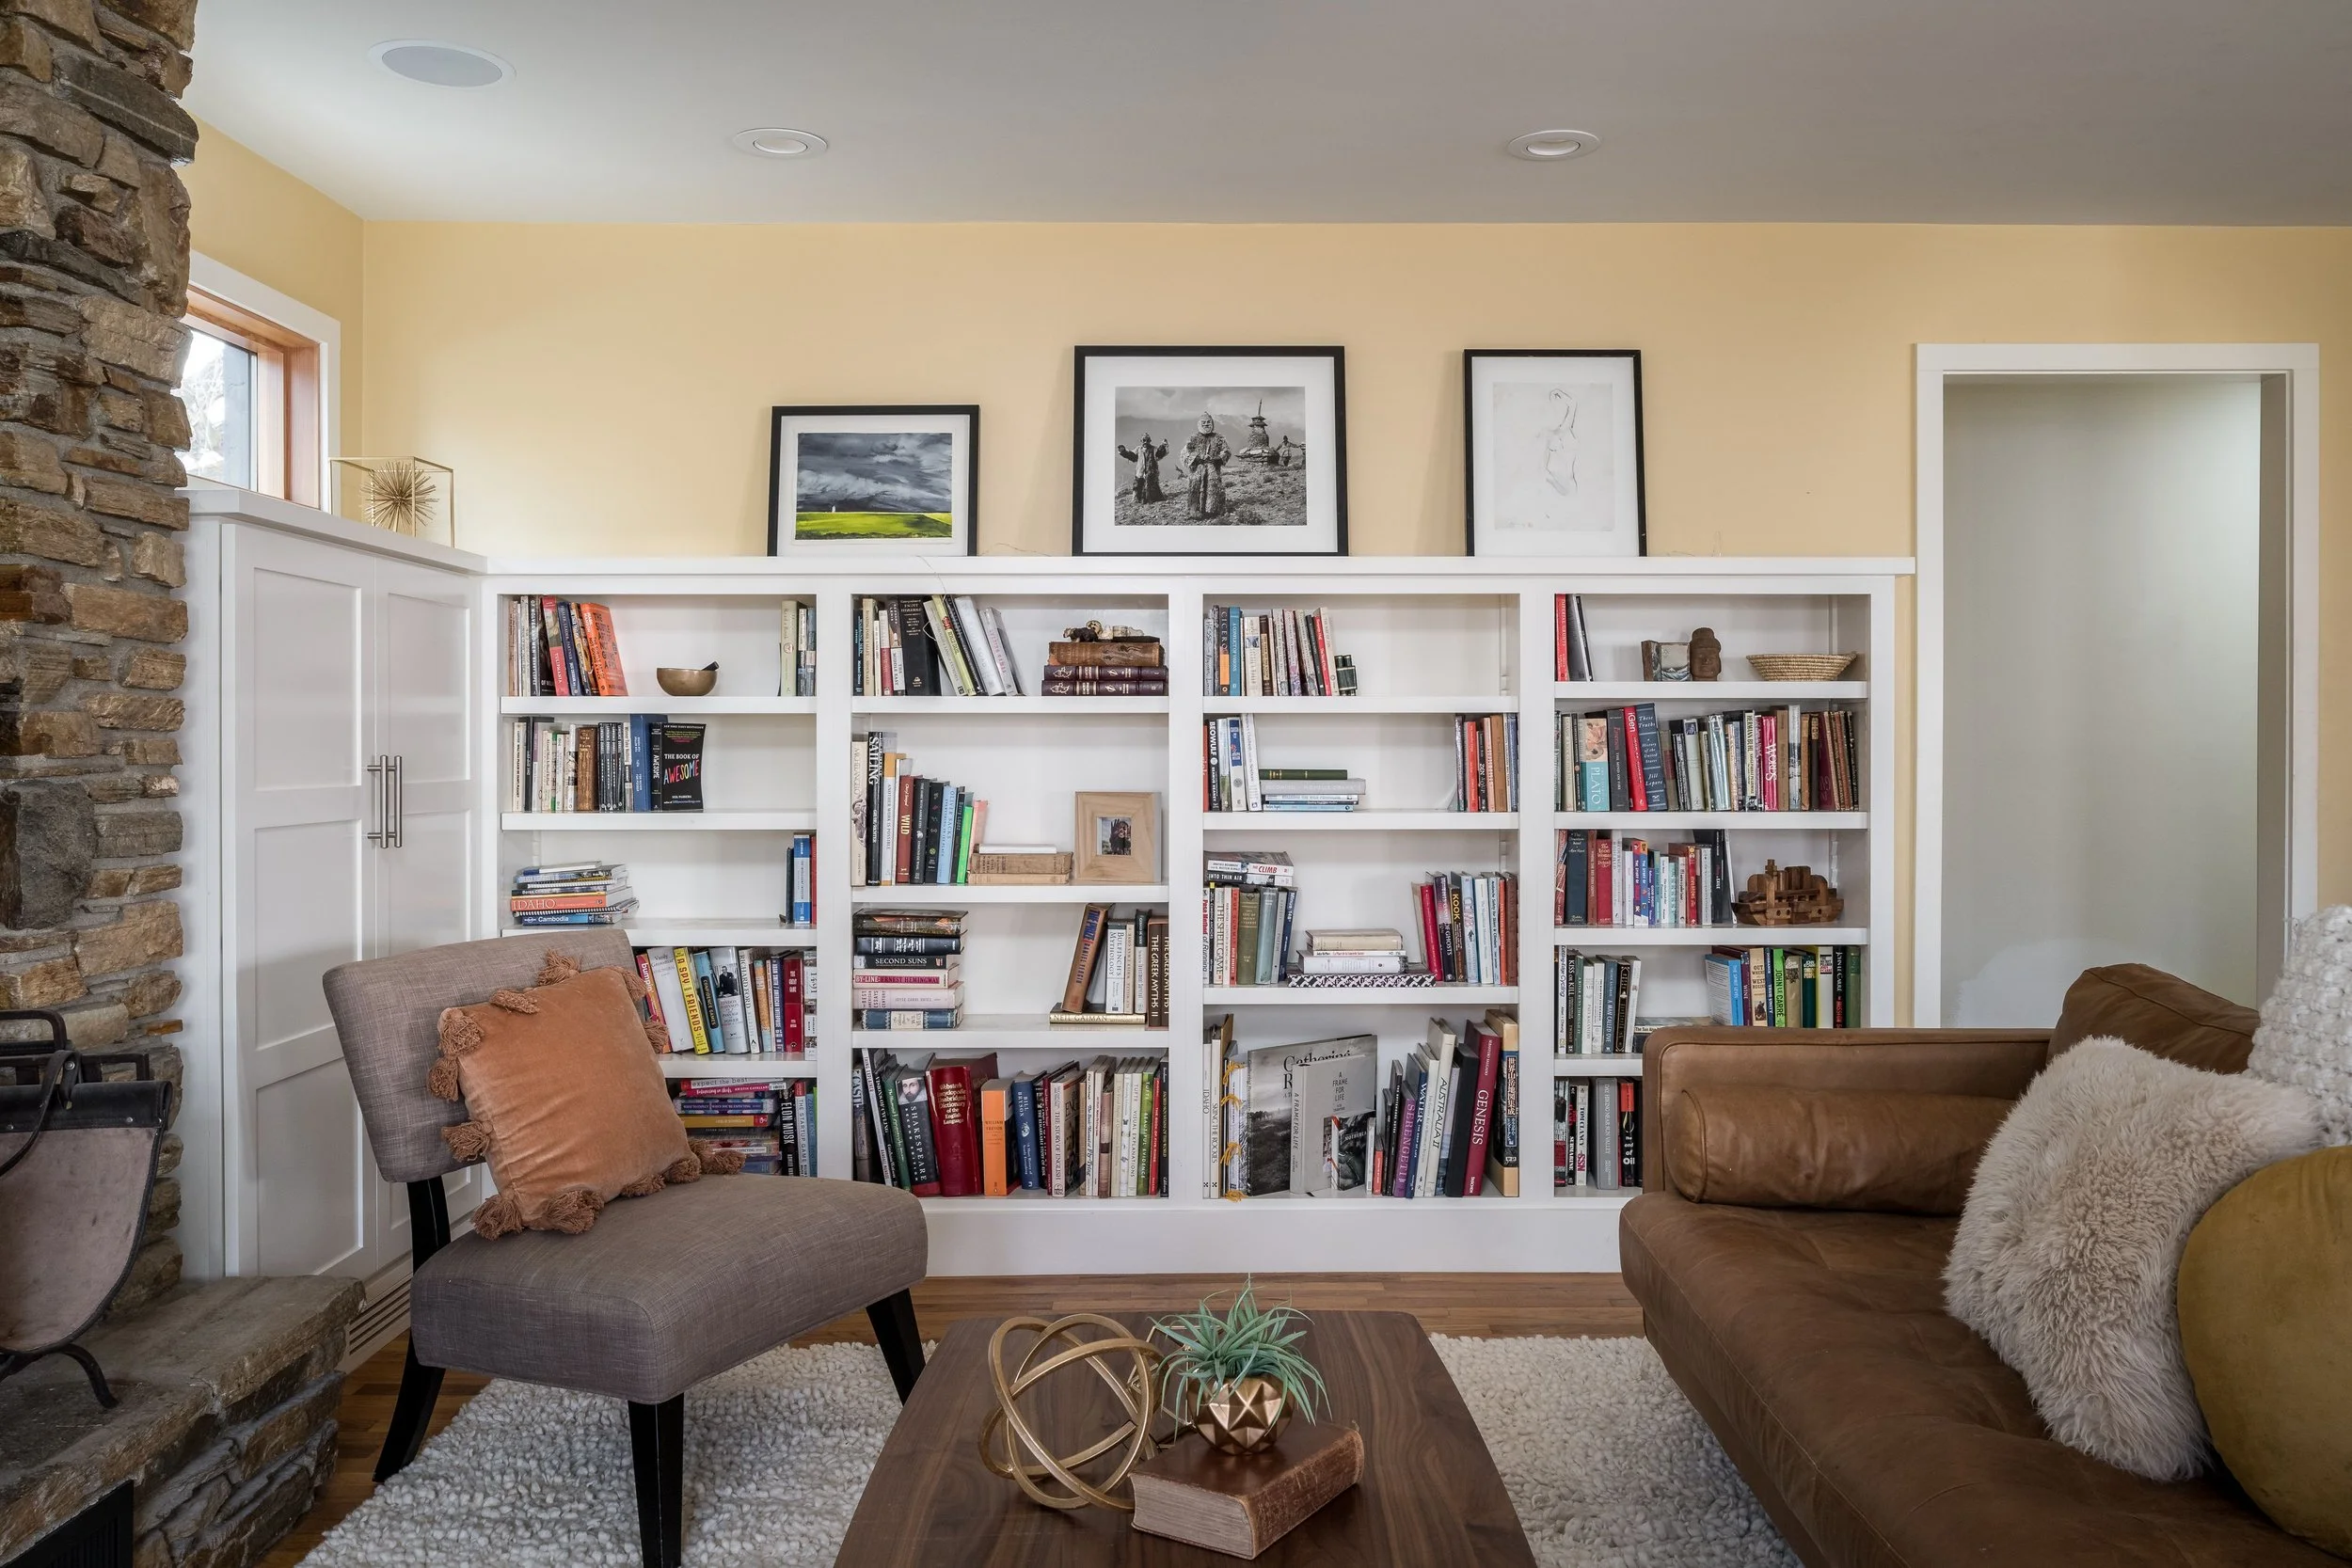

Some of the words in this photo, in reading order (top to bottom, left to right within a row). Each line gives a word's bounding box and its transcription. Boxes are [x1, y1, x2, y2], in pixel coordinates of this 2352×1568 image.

[1628, 712, 1636, 732] iGen
[868, 736, 879, 784] SAILING
[1765, 742, 1777, 782] WORDS
[664, 760, 699, 785] AWESOME
[1591, 768, 1600, 804] PLATO
[901, 815, 910, 834] WILD
[1259, 865, 1277, 874] CLIMB
[513, 898, 556, 910] IDAHO
[1088, 911, 1100, 922] THE
[1083, 922, 1098, 941] PRIZE
[1080, 943, 1090, 962] DANIEL
[679, 968, 691, 984] SPY
[739, 955, 749, 988] RICHARD
[1774, 969, 1783, 987] JOHN
[703, 979, 713, 1008] CONFIDENCE
[742, 990, 752, 1008] FORD
[685, 994, 702, 1032] FRIENDS
[1776, 994, 1785, 1018] CARRÉ
[707, 1010, 716, 1026] GAMES
[1333, 1078, 1348, 1086] FRAME
[1335, 1093, 1344, 1101] LIFE
[781, 1102, 792, 1120] ELON
[1433, 1077, 1447, 1140] AUSTRALIA
[1472, 1089, 1489, 1145] GENESIS
[783, 1123, 794, 1144] MUSK
[1399, 1104, 1415, 1179] SERENGETI
[911, 1106, 927, 1181] SHAKESPEARE
[1056, 1143, 1060, 1151] OF
